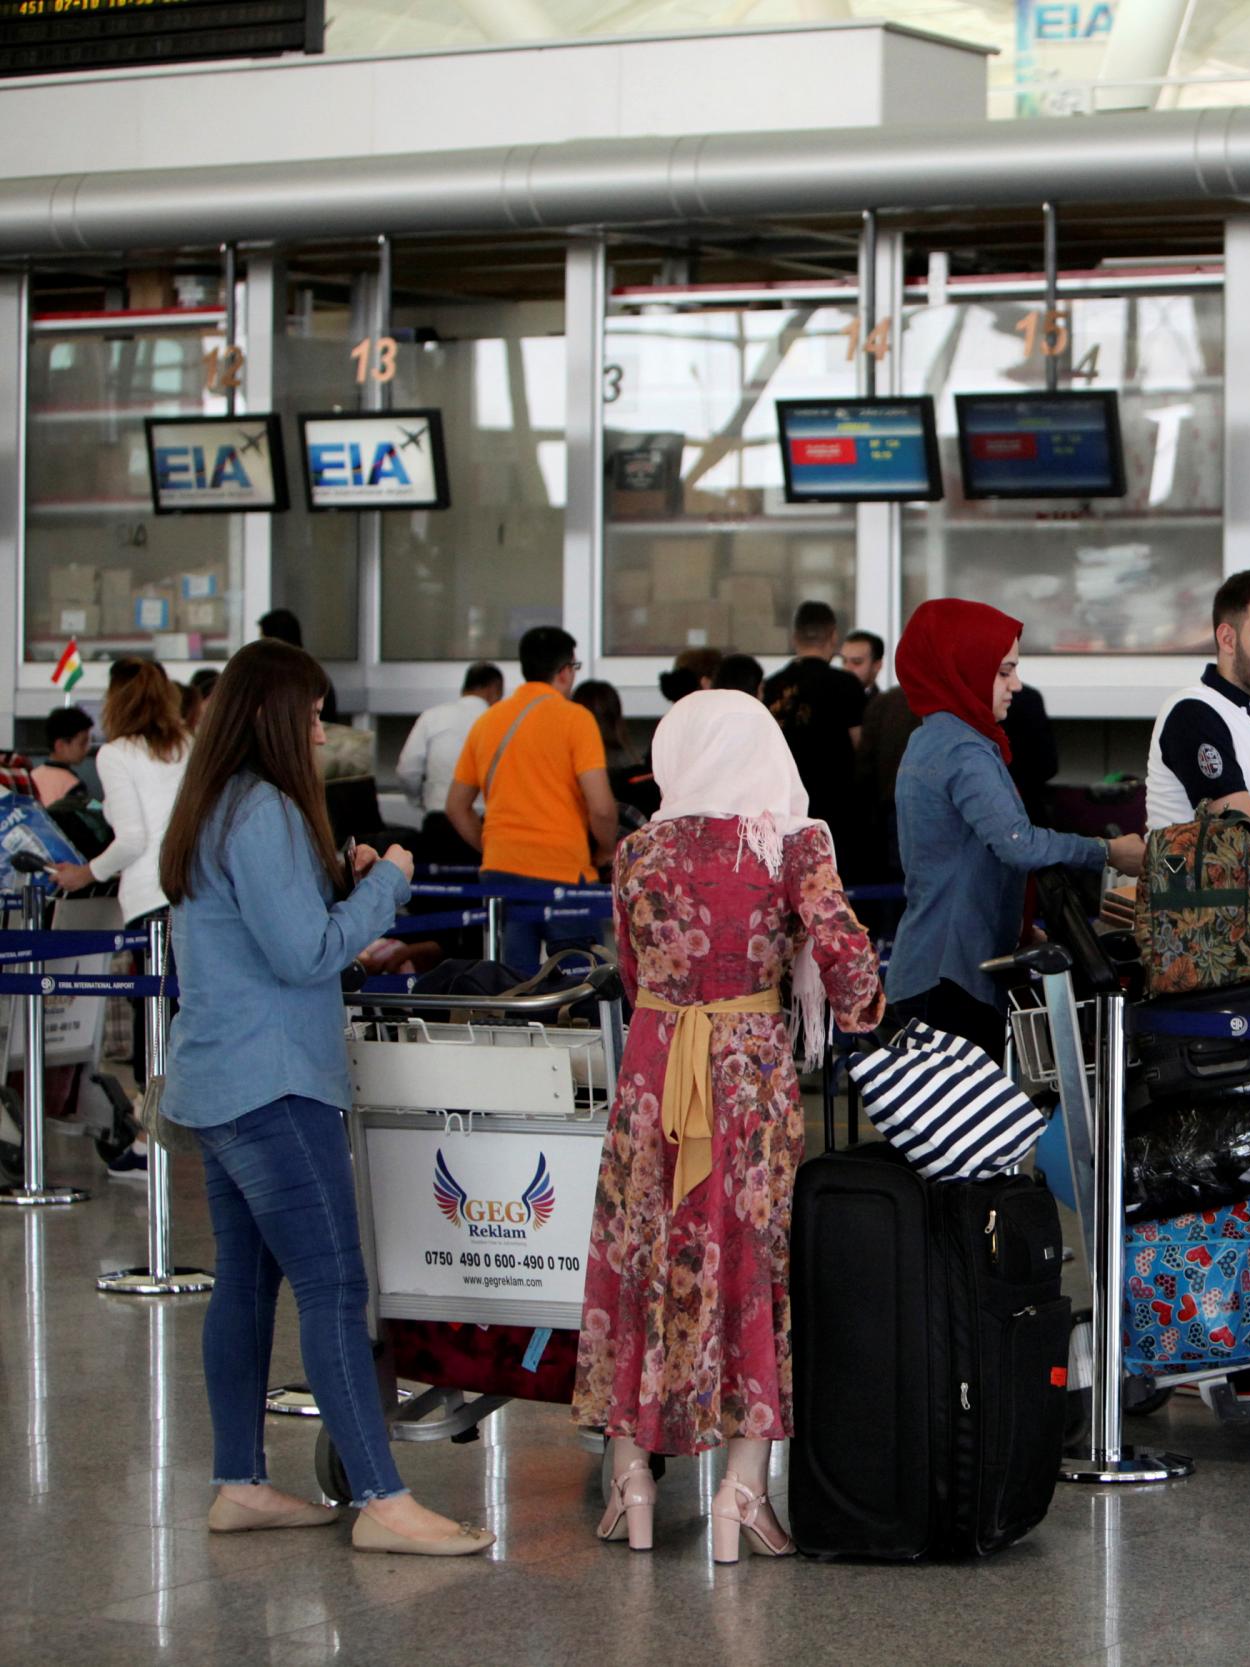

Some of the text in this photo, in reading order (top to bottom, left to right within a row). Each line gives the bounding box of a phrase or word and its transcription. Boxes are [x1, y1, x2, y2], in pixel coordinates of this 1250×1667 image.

[1035, 3, 1114, 38] EIA
[840, 316, 891, 362] 14
[1016, 310, 1070, 357] 15
[202, 345, 244, 388] 12
[351, 336, 398, 384] 13
[155, 445, 253, 490] EIA
[308, 442, 412, 486] EIA
[465, 1200, 524, 1223] GEG
[468, 1224, 526, 1239] Reklam
[425, 1251, 453, 1266] 0750
[460, 1252, 480, 1267] 490
[484, 1254, 491, 1268] 0
[548, 1256, 555, 1270] 0
[558, 1257, 580, 1271] 700
[463, 1275, 542, 1288] www.gegreklam.com
